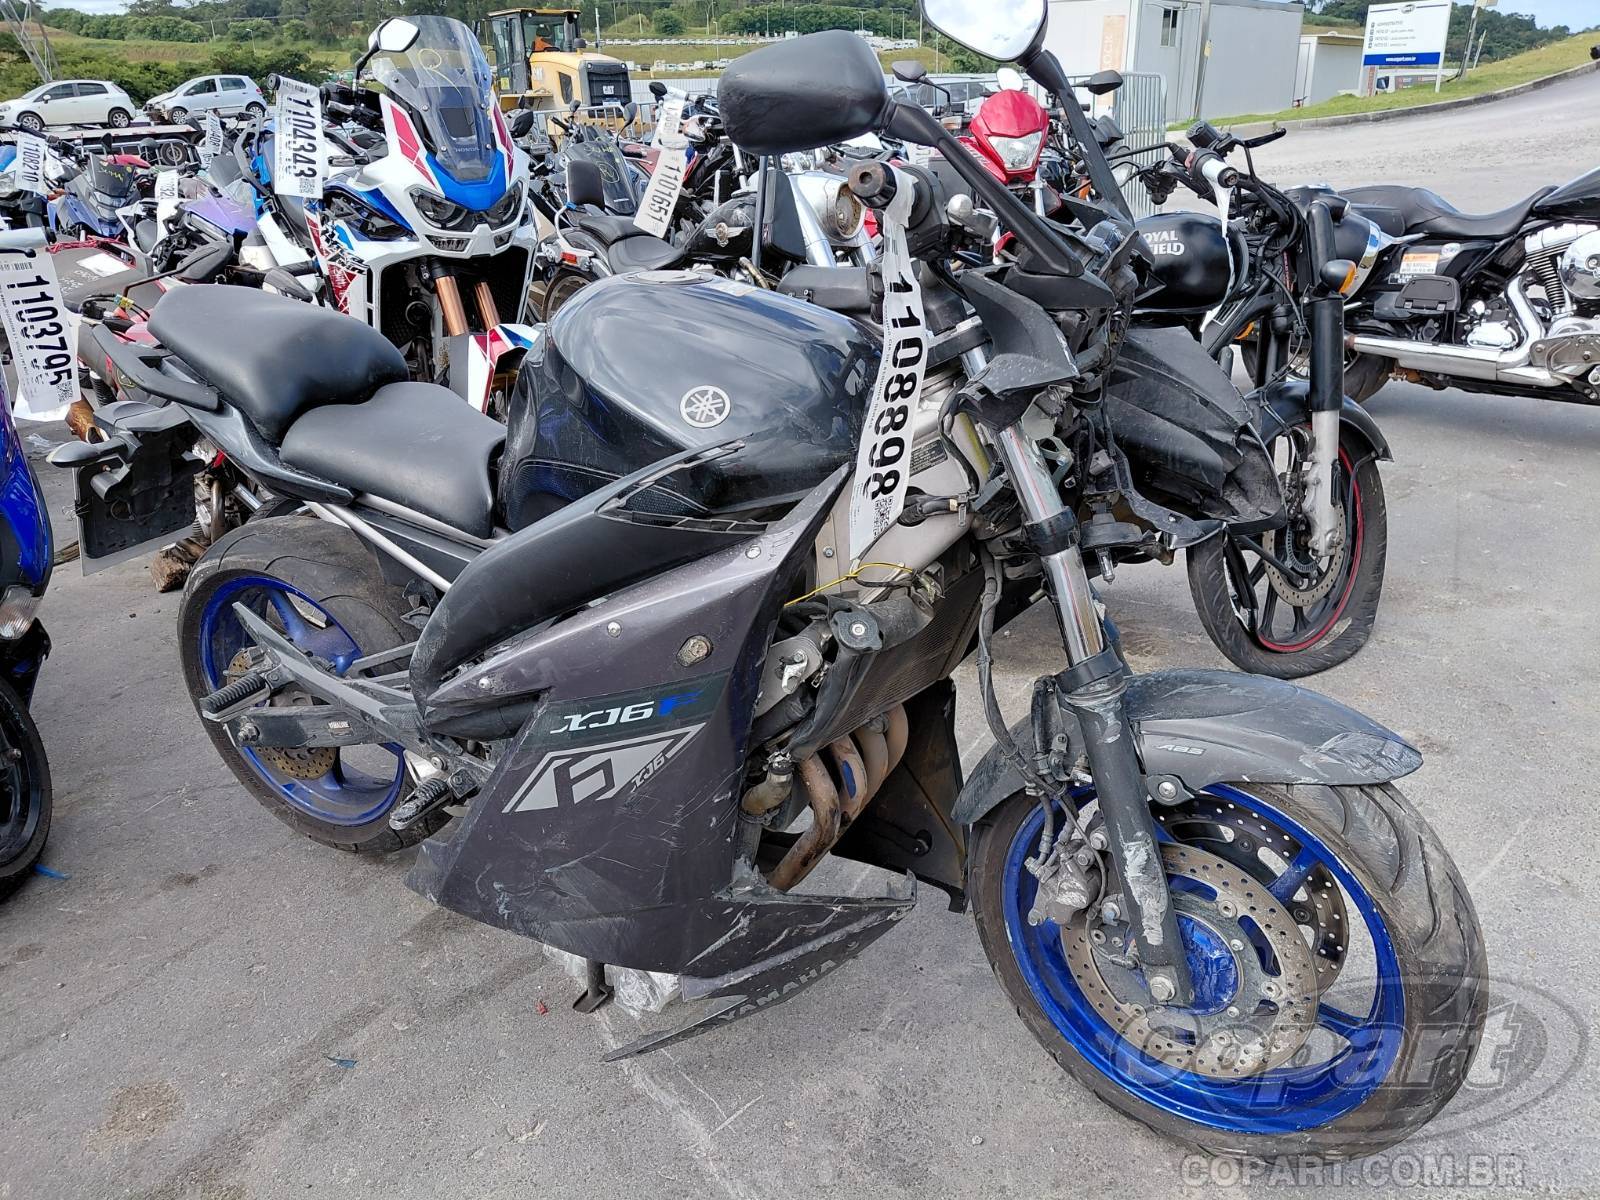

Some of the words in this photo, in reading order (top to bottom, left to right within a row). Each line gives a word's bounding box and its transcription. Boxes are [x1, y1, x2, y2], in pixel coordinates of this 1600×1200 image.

[286, 97, 317, 178] 1104343
[648, 164, 681, 224] 1101651
[1143, 230, 1178, 242] OYAL
[7, 275, 72, 385] 1103795
[863, 272, 923, 500] 1108898
[717, 959, 837, 1021] YAMAHA
